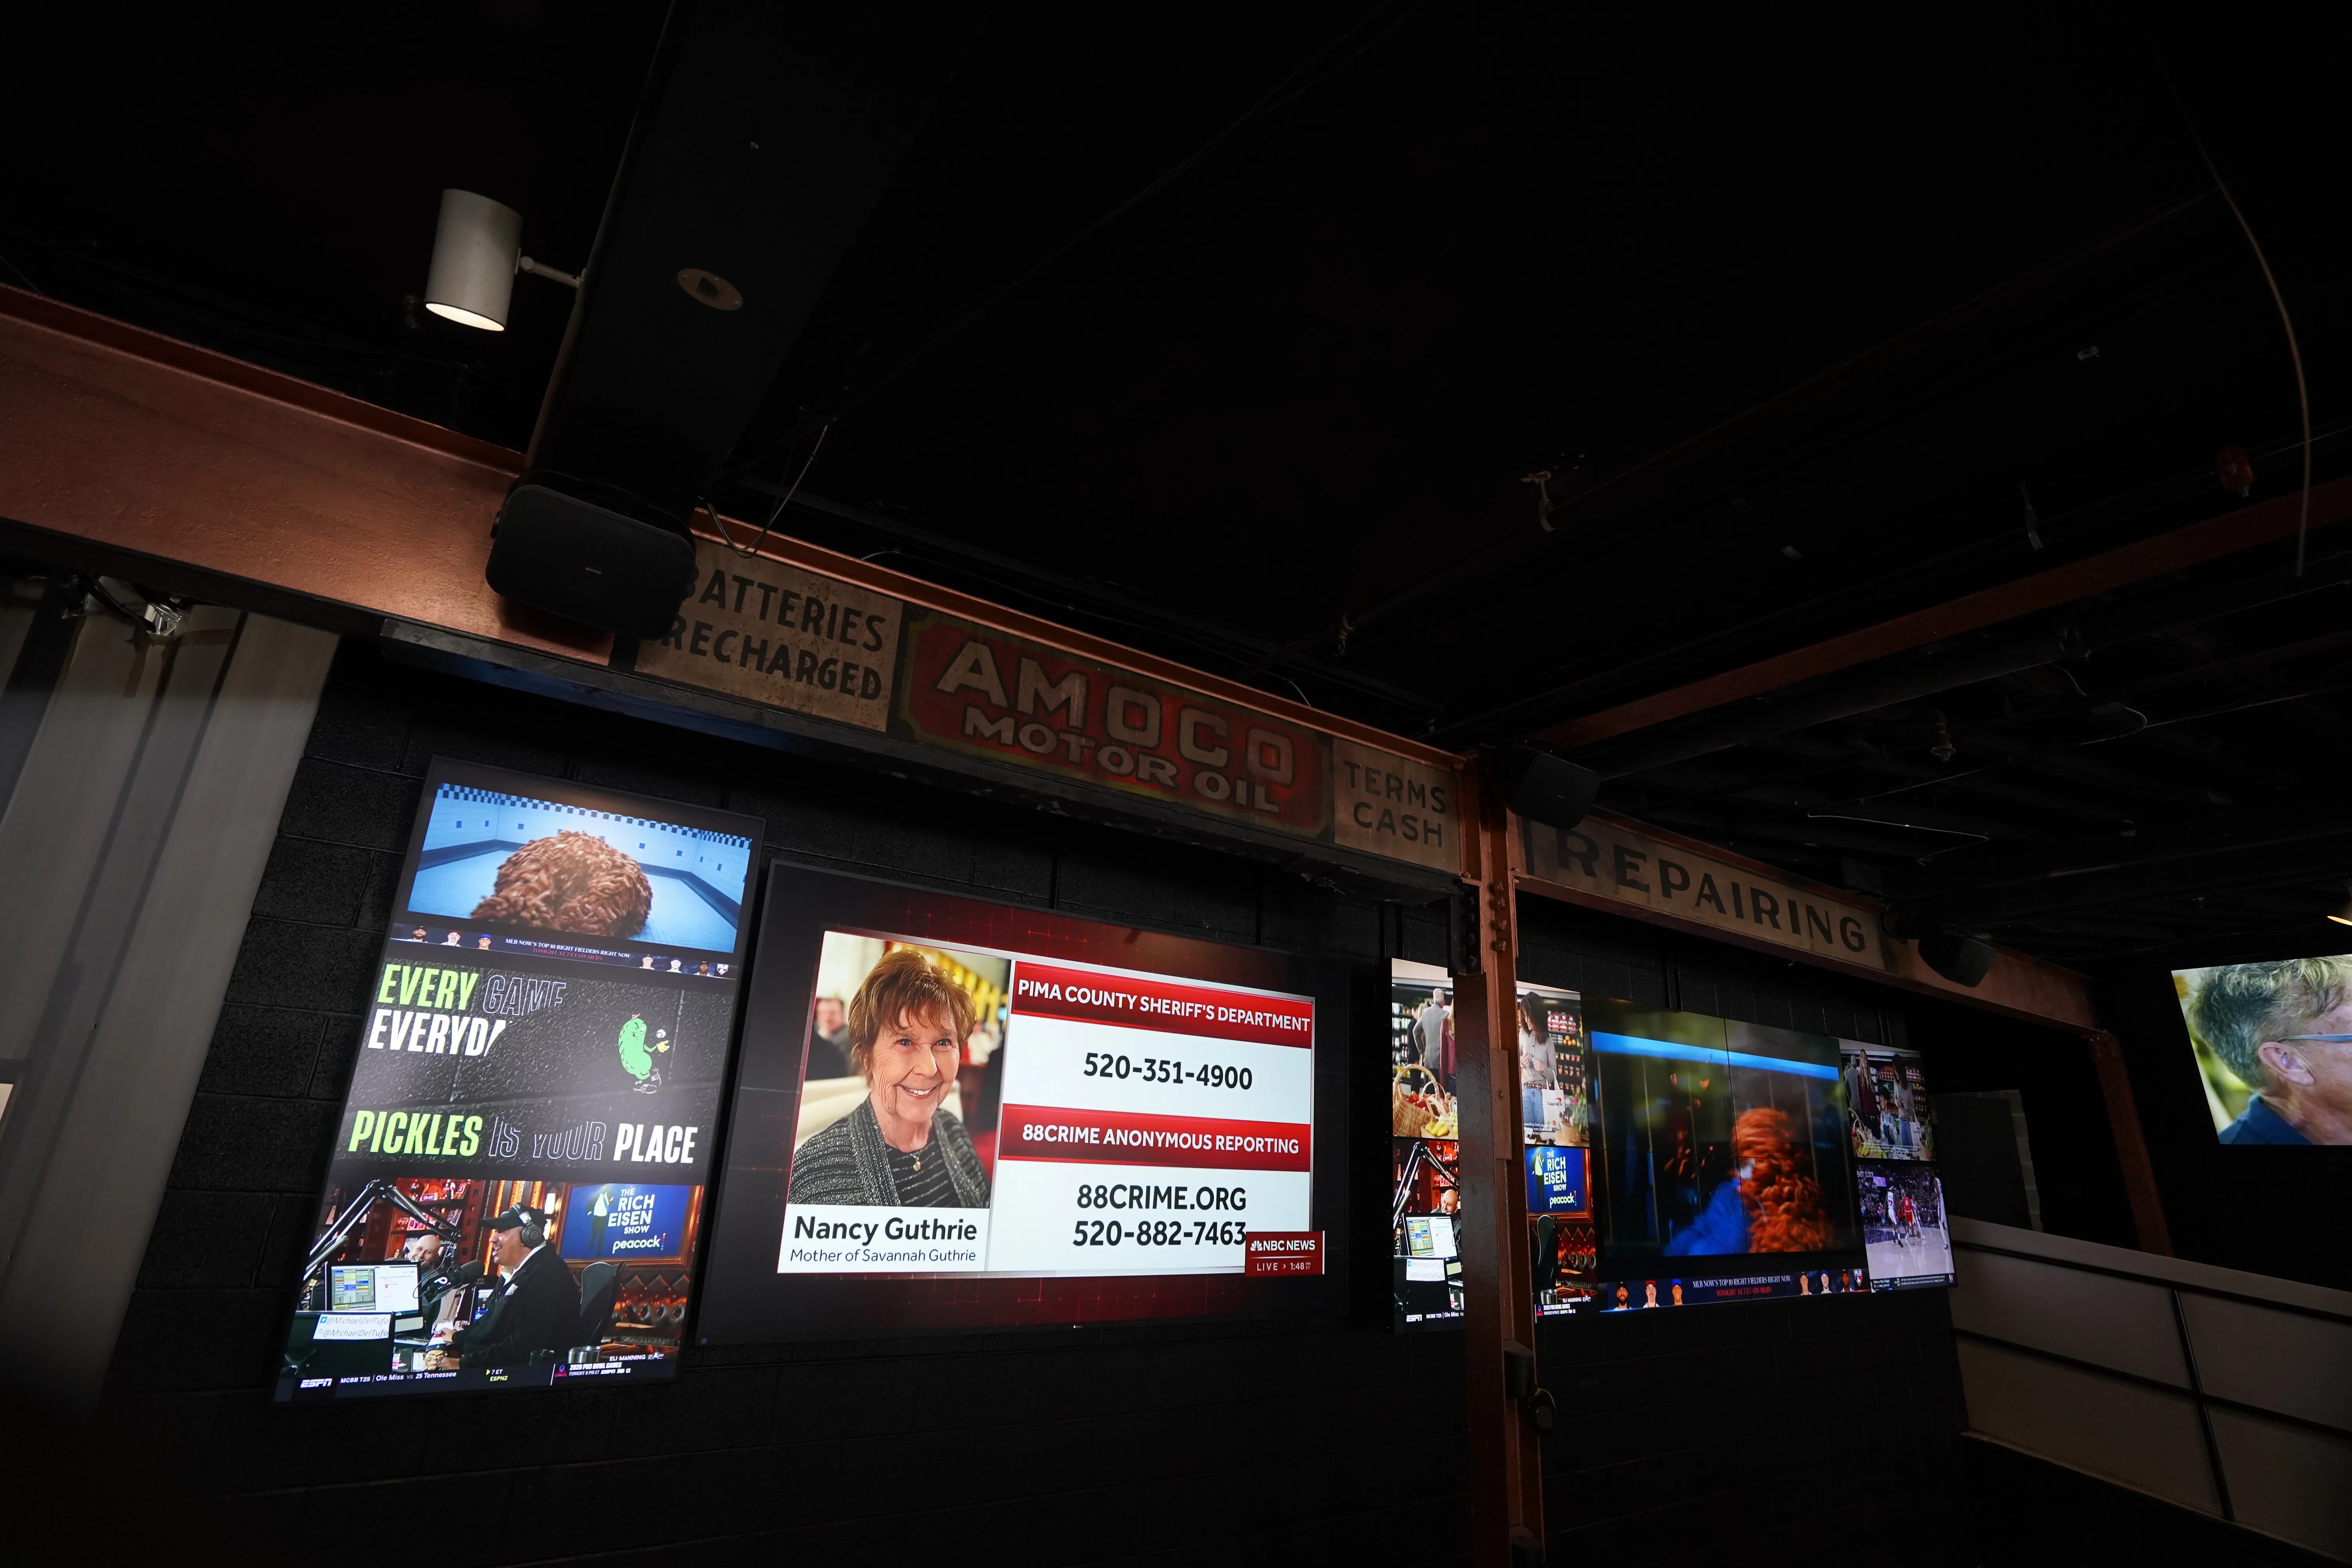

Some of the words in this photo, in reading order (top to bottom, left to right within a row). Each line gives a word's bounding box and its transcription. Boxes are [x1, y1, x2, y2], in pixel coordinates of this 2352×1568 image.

[693, 568, 886, 652] ATTERIES
[661, 615, 881, 700] RECHARGED
[936, 640, 1293, 787] AMOCO
[963, 707, 1178, 788] MOTOR
[1193, 771, 1281, 815] OIL
[1343, 760, 1446, 814] TERMS
[1353, 801, 1442, 848] CASH
[1555, 827, 1866, 953] REPAIRING
[377, 964, 479, 1011] EVERY
[483, 975, 566, 1016] GAME
[1018, 979, 1062, 1000] PIMA
[1065, 985, 1137, 1009] COUNTY
[1140, 996, 1215, 1021] SHERIFF'S
[1218, 1006, 1311, 1032] DEPARTMENT
[368, 1009, 512, 1057] EVERYD
[1083, 1052, 1253, 1090] 520-351-4900
[348, 1110, 483, 1156] PICKLES
[488, 1116, 521, 1158] IS
[532, 1121, 606, 1160] YOUR
[613, 1123, 698, 1164] PLACE
[1022, 1123, 1100, 1145] 88CRIME
[1103, 1128, 1212, 1151] ANONYMOUS
[1215, 1136, 1299, 1154] REPORTING
[1547, 1156, 1566, 1171] RICH
[1544, 1170, 1567, 1185] EISEN
[618, 1194, 655, 1211] RICH
[621, 1188, 635, 1197] THE
[1076, 1184, 1247, 1211] 88CRIME.ORG
[1550, 1192, 1574, 1209] peacock
[608, 1210, 653, 1227] EISEN
[624, 1225, 650, 1234] SHOW
[794, 1216, 879, 1246] Nancy
[885, 1218, 977, 1241] Guthrie
[1073, 1220, 1246, 1247] 520-882-7463
[612, 1235, 661, 1254] peacock
[790, 1249, 842, 1262] Mother
[845, 1249, 860, 1262] of
[862, 1249, 926, 1261] Savannah
[929, 1249, 976, 1261] Guthrie
[1263, 1240, 1285, 1251] NBC
[1287, 1240, 1315, 1251] NEWS
[1257, 1262, 1278, 1271] LIVE
[1290, 1262, 1305, 1270] 1:48
[1704, 1279, 1719, 1288] NOW'S
[1734, 1278, 1747, 1286] RIGHT
[1748, 1276, 1768, 1285] FIELDERS
[1716, 1288, 1736, 1297] TONIGHT
[326, 1317, 389, 1326] @MichaelDelTufo
[323, 1329, 389, 1338] @MichaelDelTufo
[300, 1378, 332, 1388] ESPN
